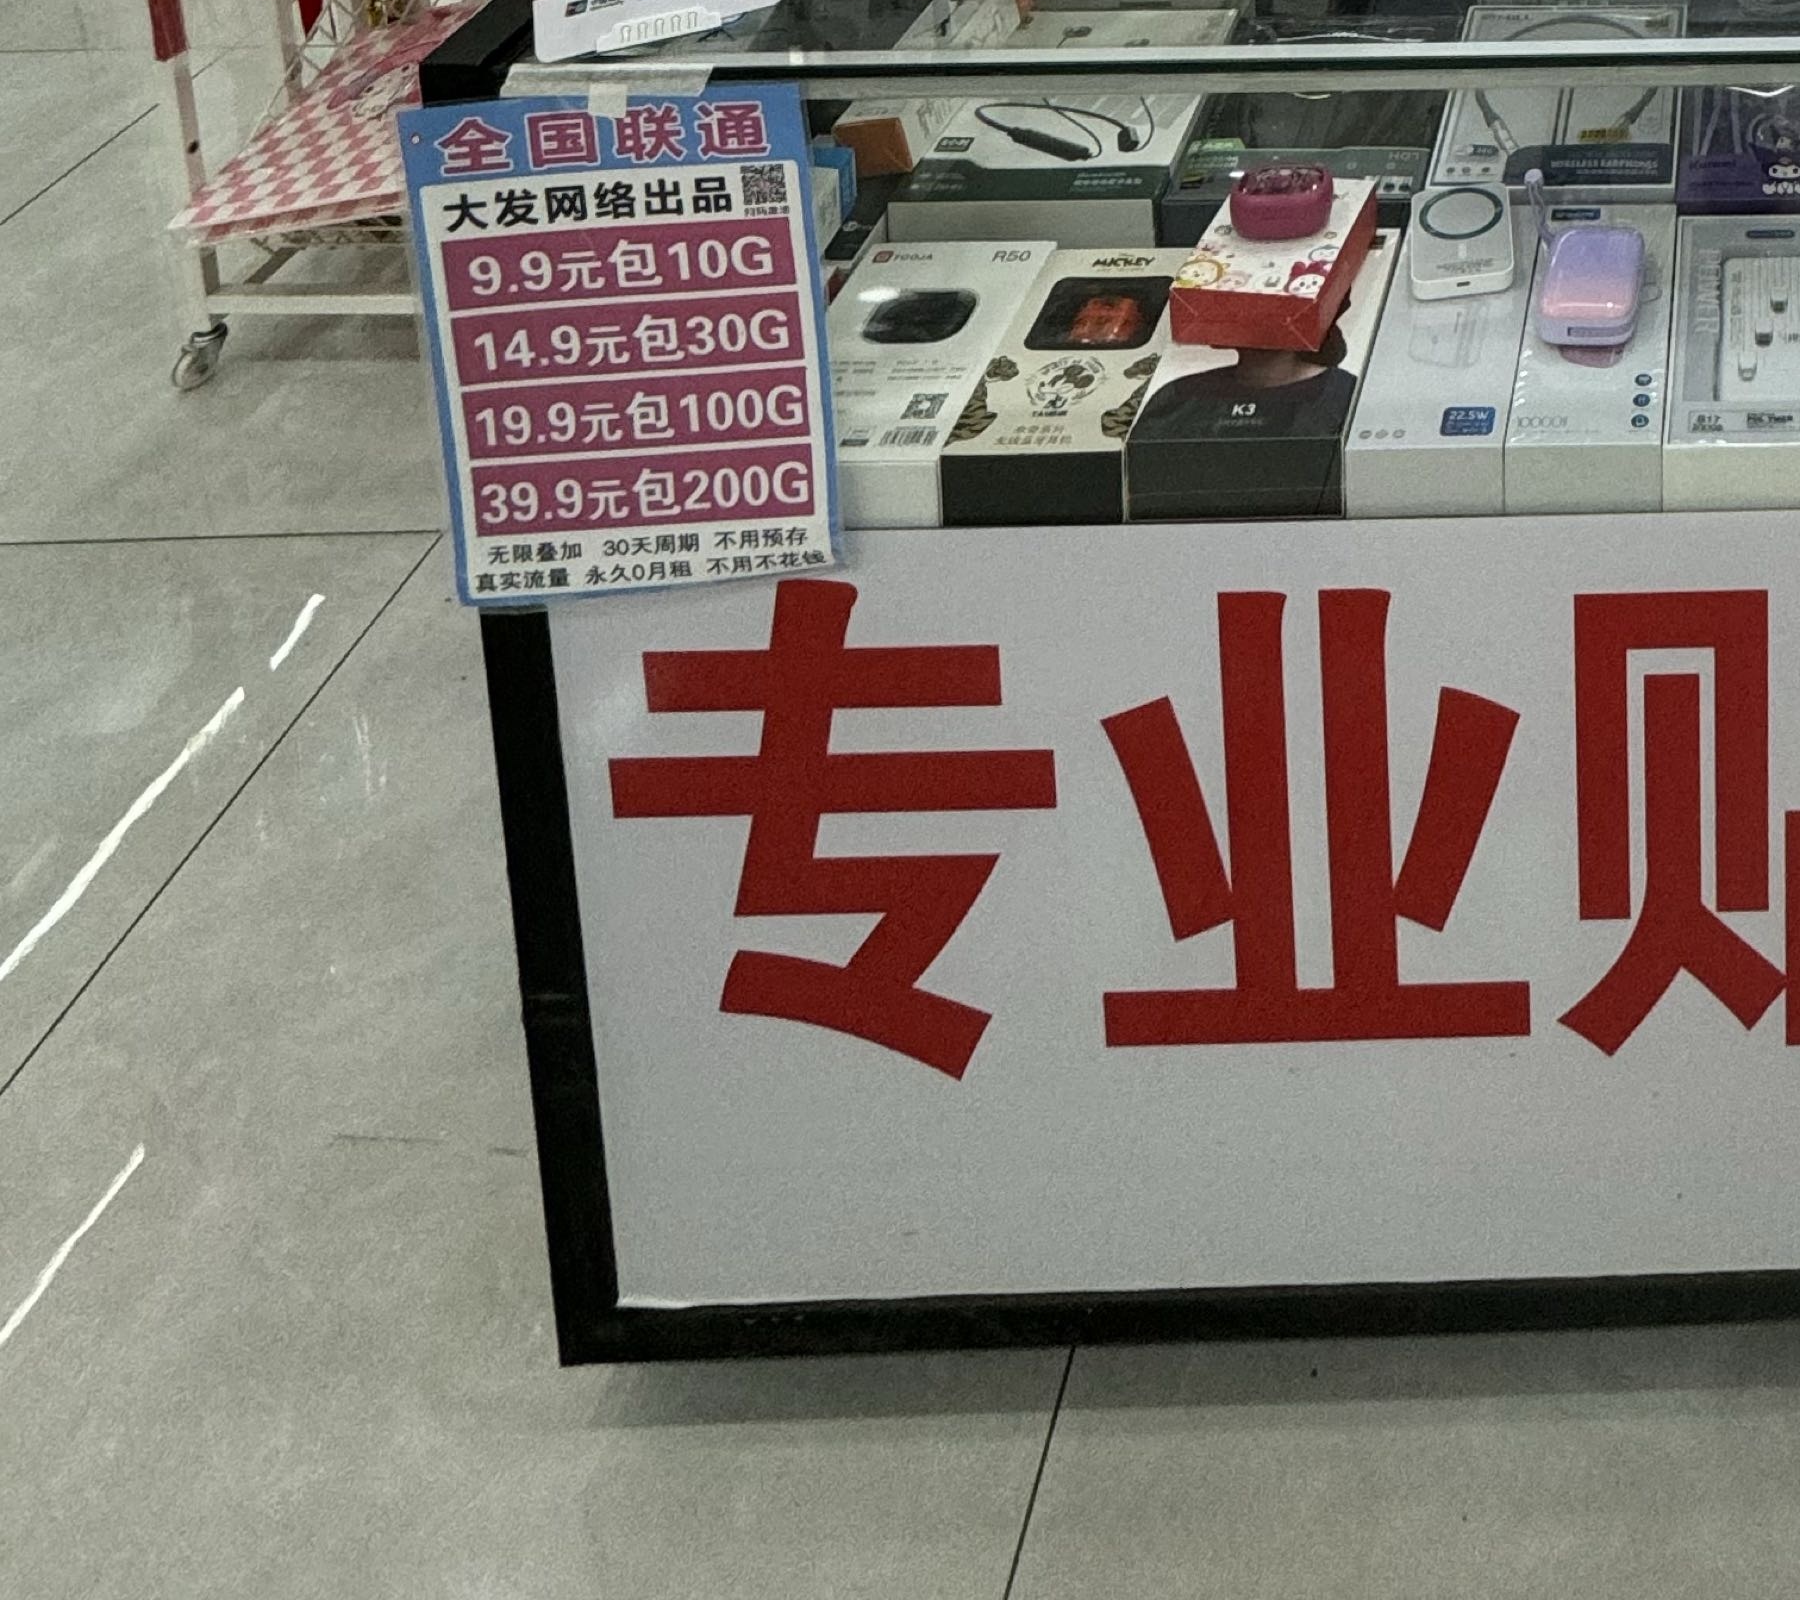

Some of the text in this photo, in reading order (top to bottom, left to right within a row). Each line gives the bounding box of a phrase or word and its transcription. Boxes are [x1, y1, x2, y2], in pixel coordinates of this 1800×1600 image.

[438, 102, 770, 176] 全国联通
[443, 176, 733, 233] 大发网络出品
[467, 234, 775, 297] 9.9元包10G
[992, 250, 1032, 264] R50
[474, 308, 790, 372] 14.9元包30G
[475, 384, 804, 448] 19.9元包100G
[1231, 402, 1257, 417] K3
[1447, 408, 1490, 422] 22.5W
[480, 460, 811, 525] 39.9元包200G
[488, 526, 809, 565] 无限叠加 30天周期 不用预存
[475, 568, 570, 593] 真实流量
[585, 558, 693, 585] 永久0月租
